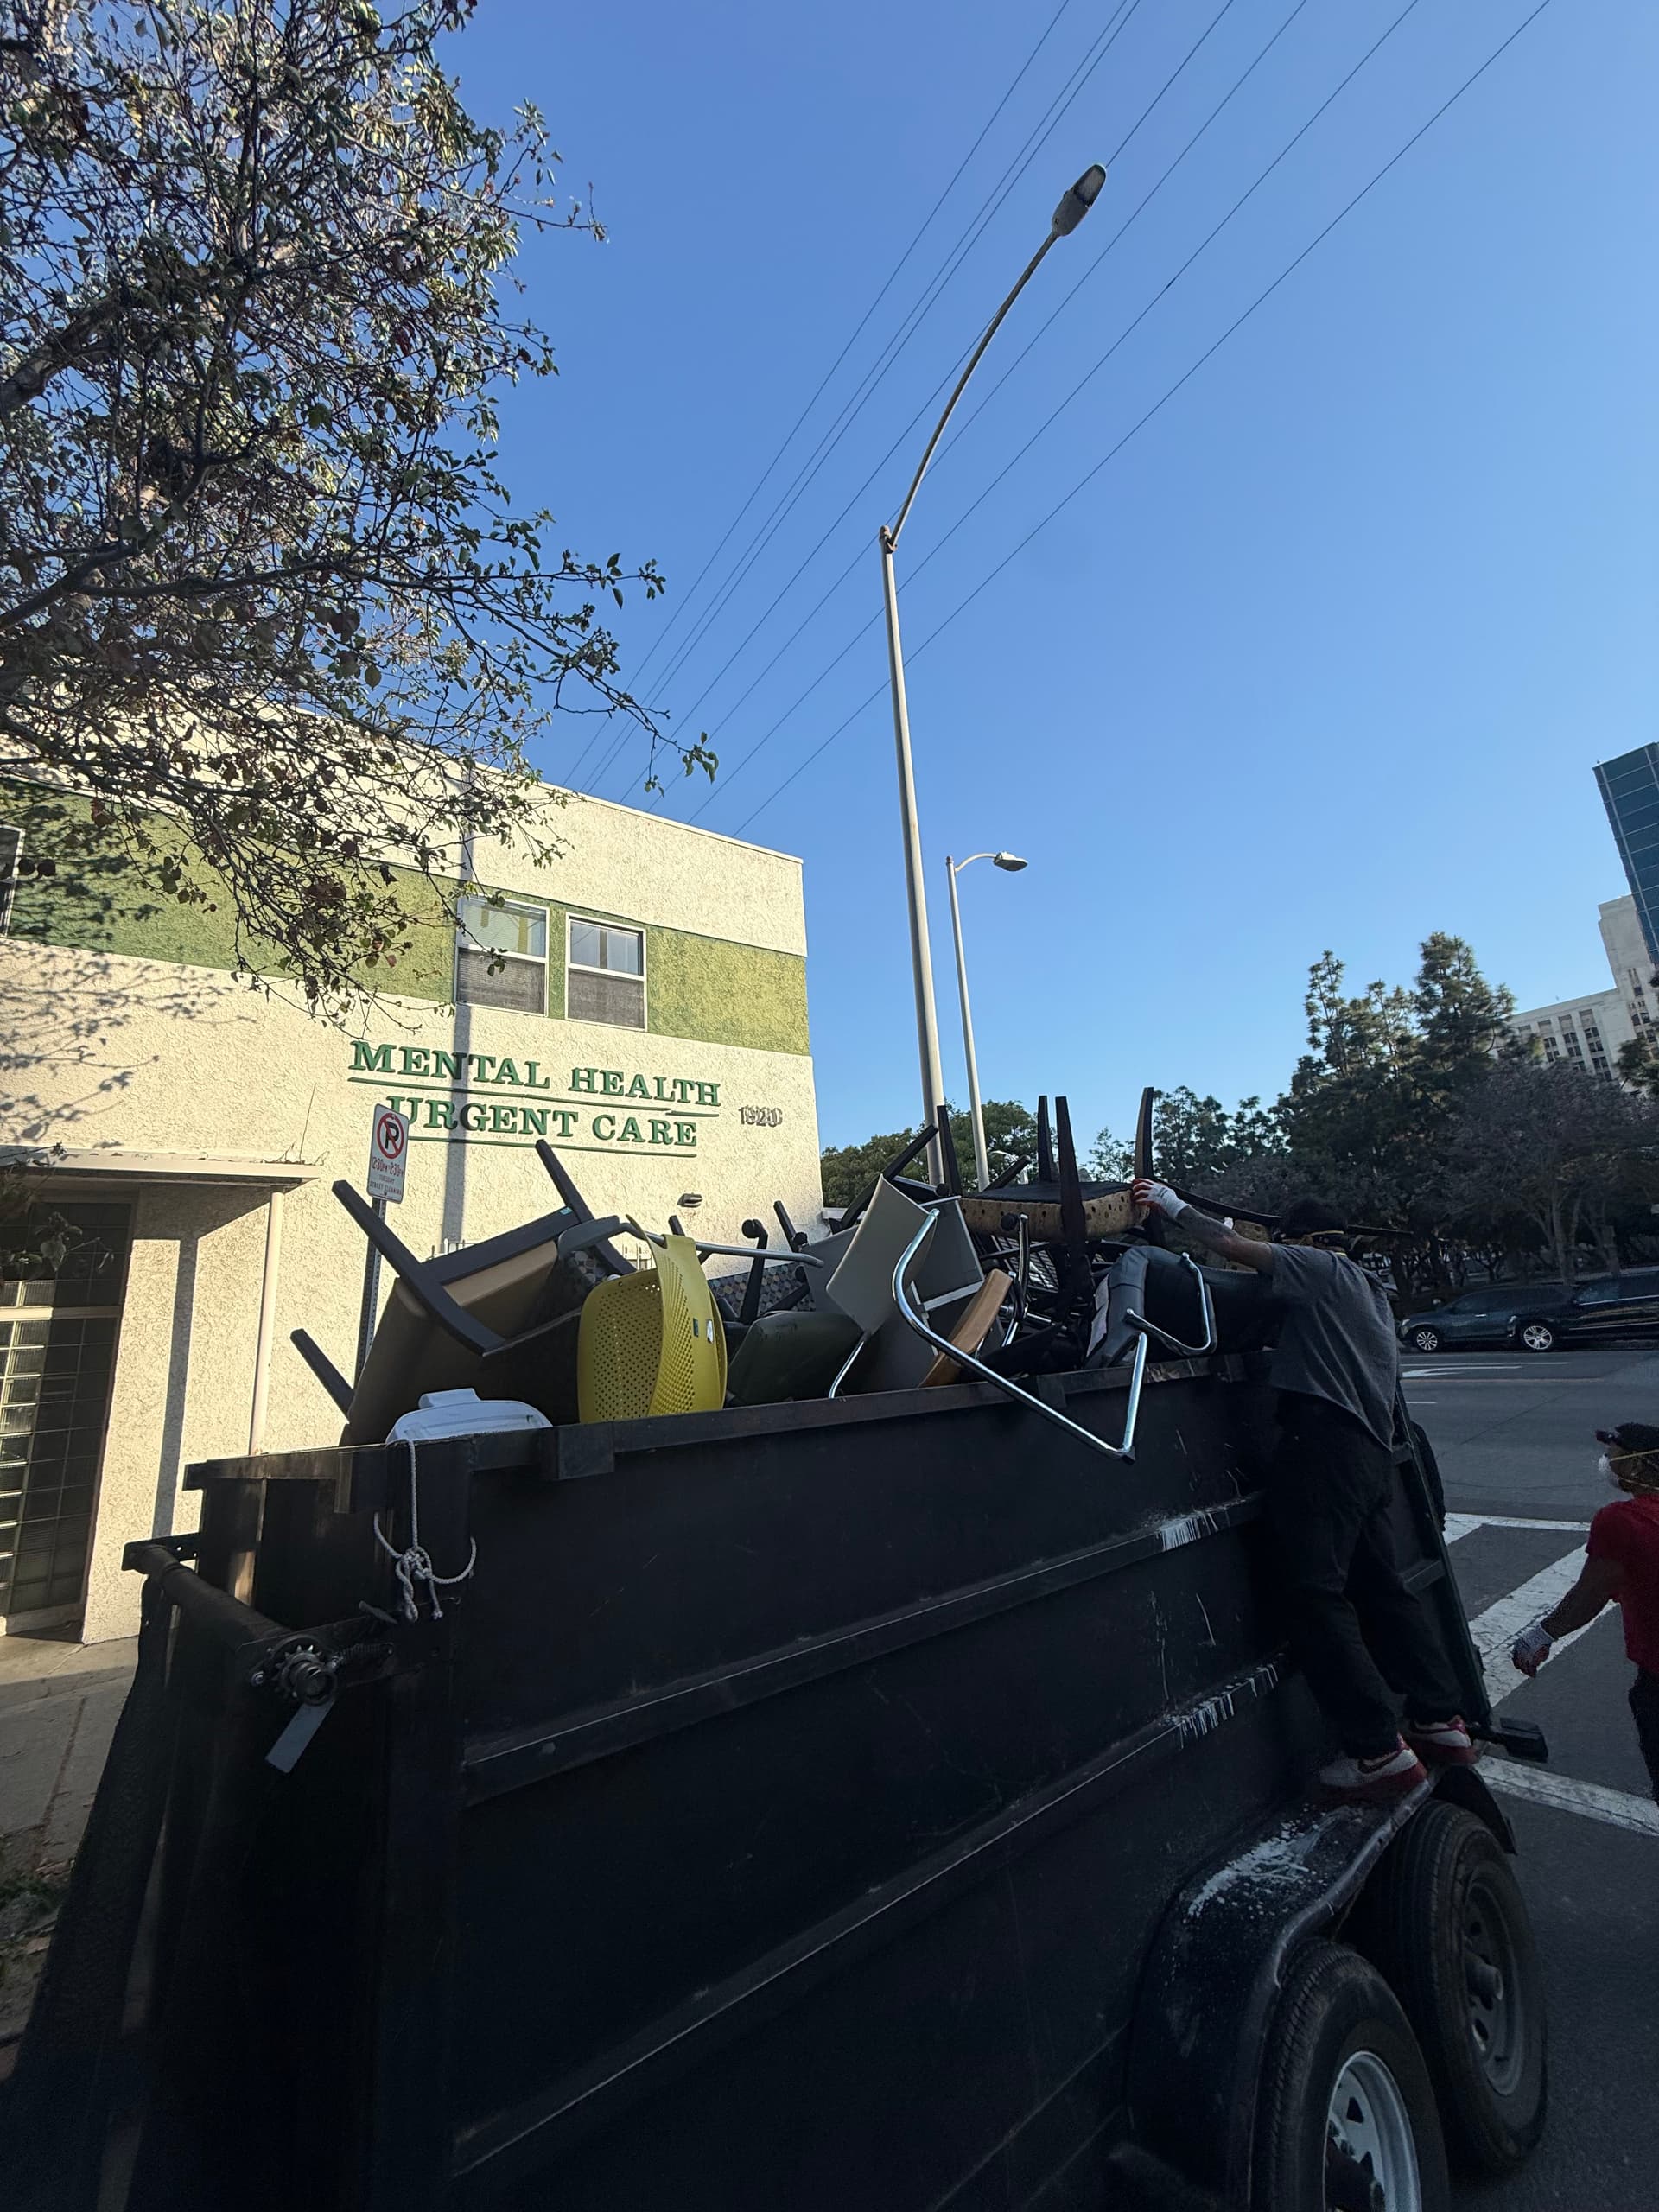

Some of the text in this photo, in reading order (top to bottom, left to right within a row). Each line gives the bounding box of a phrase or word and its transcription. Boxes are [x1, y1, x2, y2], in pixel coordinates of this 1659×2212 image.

[348, 1040, 721, 1106] MENTAL HEALTH
[386, 1096, 697, 1147] URGENT CARE
